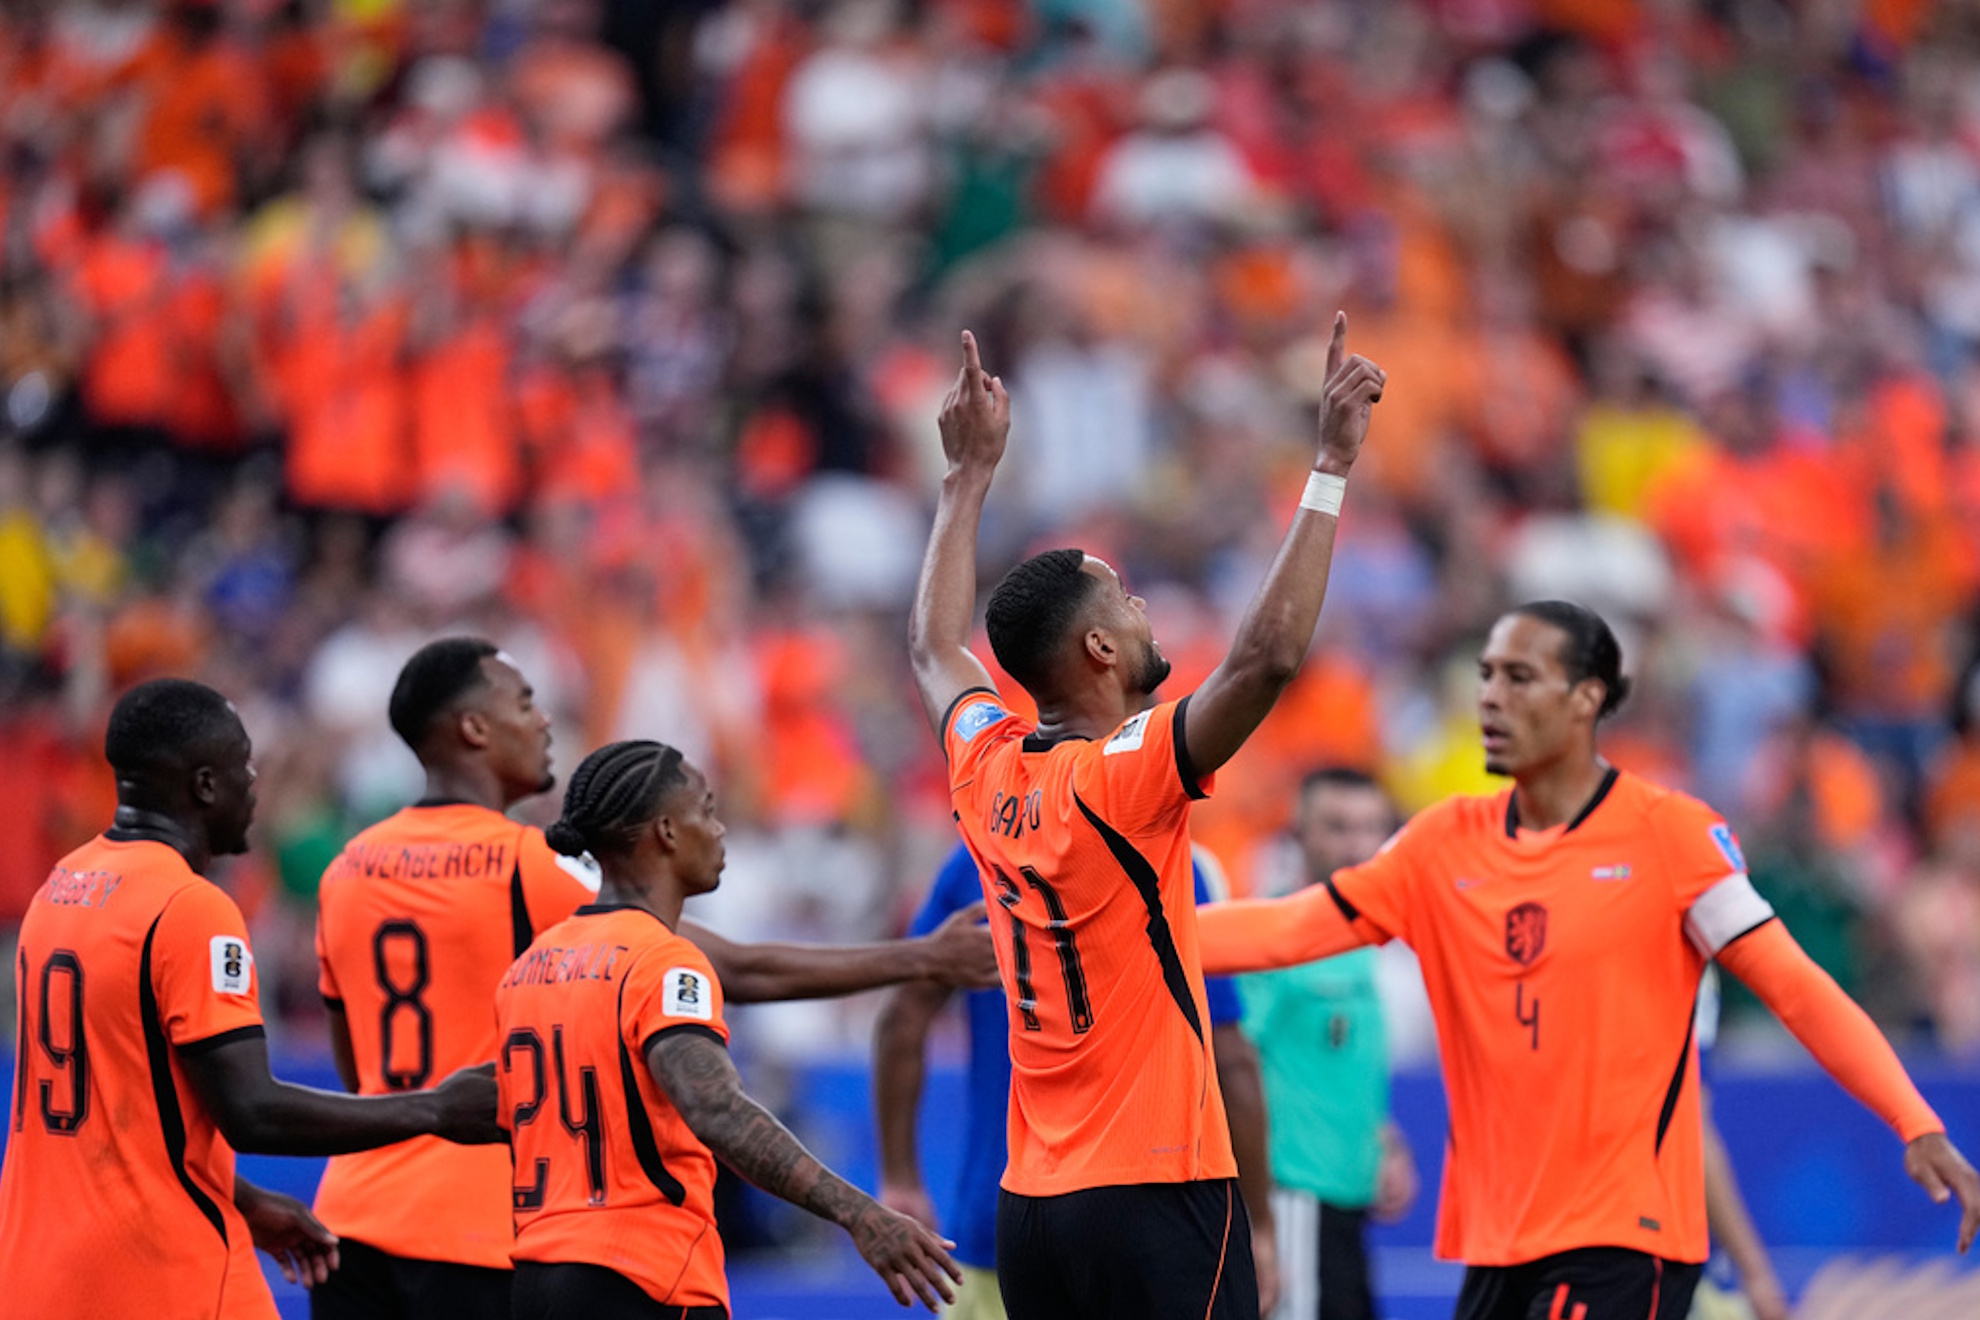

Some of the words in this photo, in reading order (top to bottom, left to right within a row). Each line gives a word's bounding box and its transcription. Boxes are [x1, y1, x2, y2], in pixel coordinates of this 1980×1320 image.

[371, 917, 433, 1091] 8
[991, 863, 1095, 1035] 11
[1515, 981, 1539, 1050] 4
[15, 946, 91, 1136] 19
[501, 1024, 608, 1213] 24
